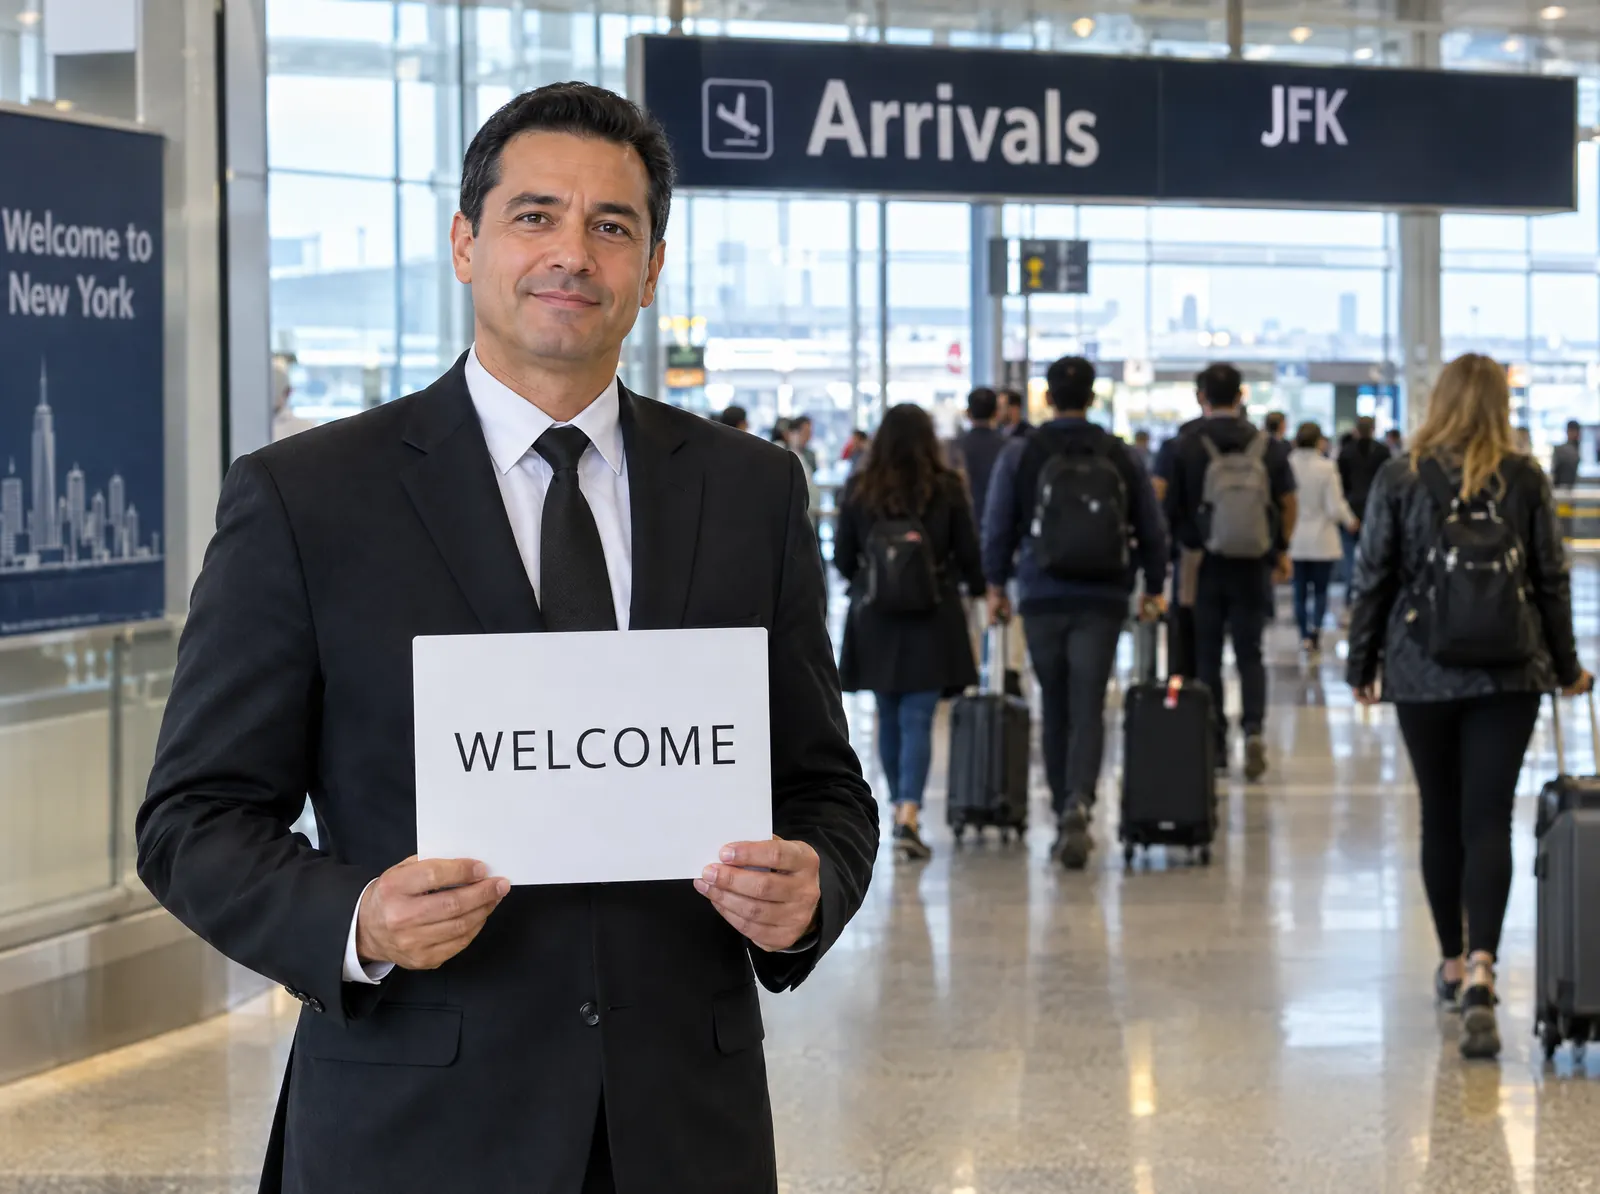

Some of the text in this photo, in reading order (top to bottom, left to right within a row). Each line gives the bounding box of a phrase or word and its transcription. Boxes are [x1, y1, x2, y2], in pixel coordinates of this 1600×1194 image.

[807, 79, 1099, 167] Arrivals
[1261, 85, 1349, 148] JFK
[2, 208, 153, 263] Welcome to
[8, 271, 135, 319] New York
[454, 724, 737, 773] WELCOME
